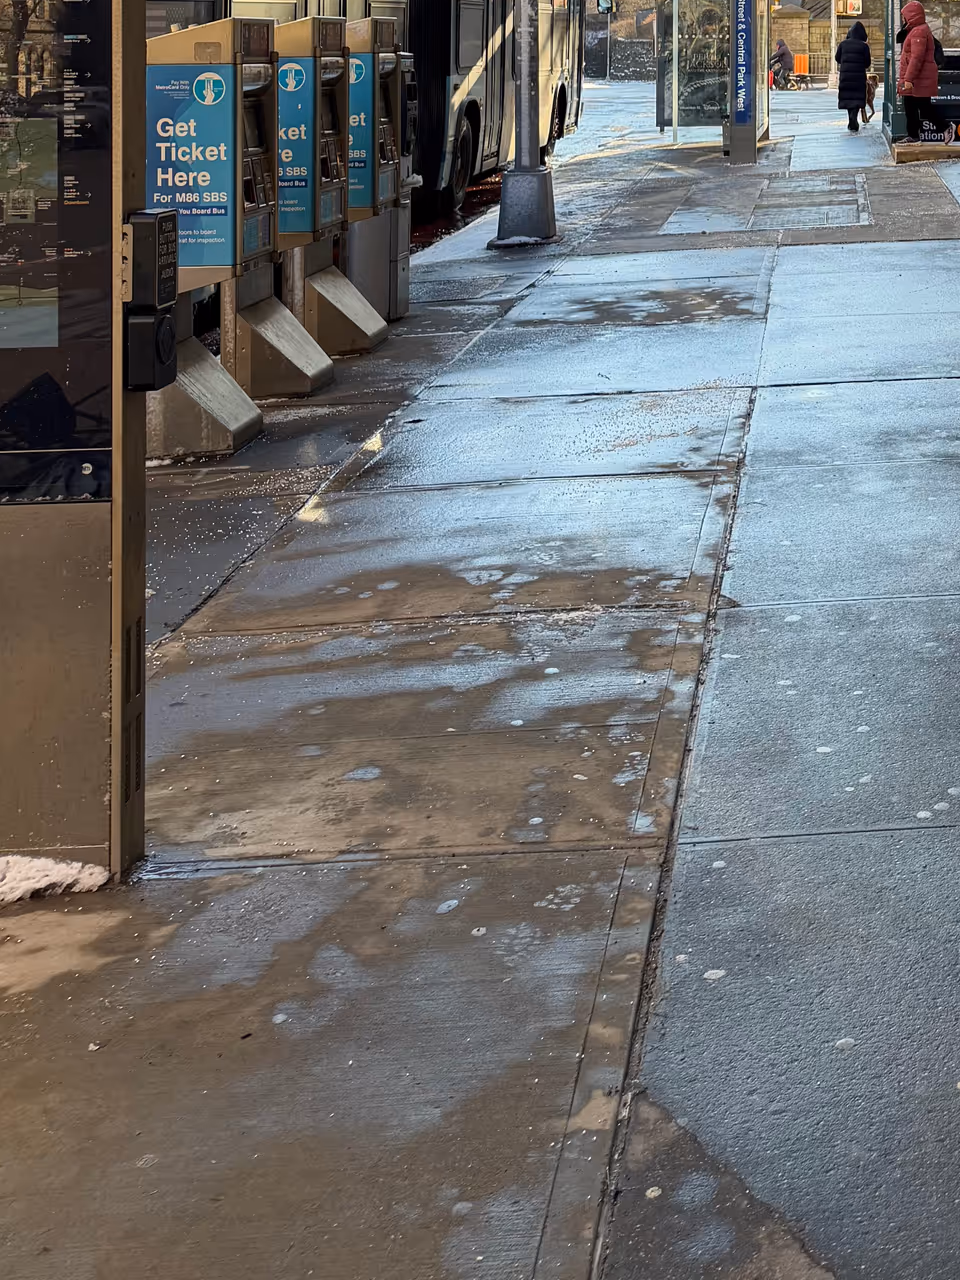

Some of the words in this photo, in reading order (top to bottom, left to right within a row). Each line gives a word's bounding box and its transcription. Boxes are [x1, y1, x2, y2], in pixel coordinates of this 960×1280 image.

[737, 32, 746, 65] Central
[737, 67, 746, 87] Park
[737, 88, 746, 111] West
[156, 118, 197, 138] Get
[155, 142, 227, 161] Ticket
[156, 167, 211, 187] Here
[286, 167, 308, 176] SBS
[153, 193, 173, 203] For
[175, 192, 200, 203] M86
[202, 192, 228, 202] SBS
[162, 221, 173, 232] PUSH
[159, 231, 176, 244] BUTTON
[197, 237, 226, 245] inspection
[159, 244, 168, 255] FOR
[168, 241, 176, 253] BUS
[160, 267, 174, 280] AUDIO
